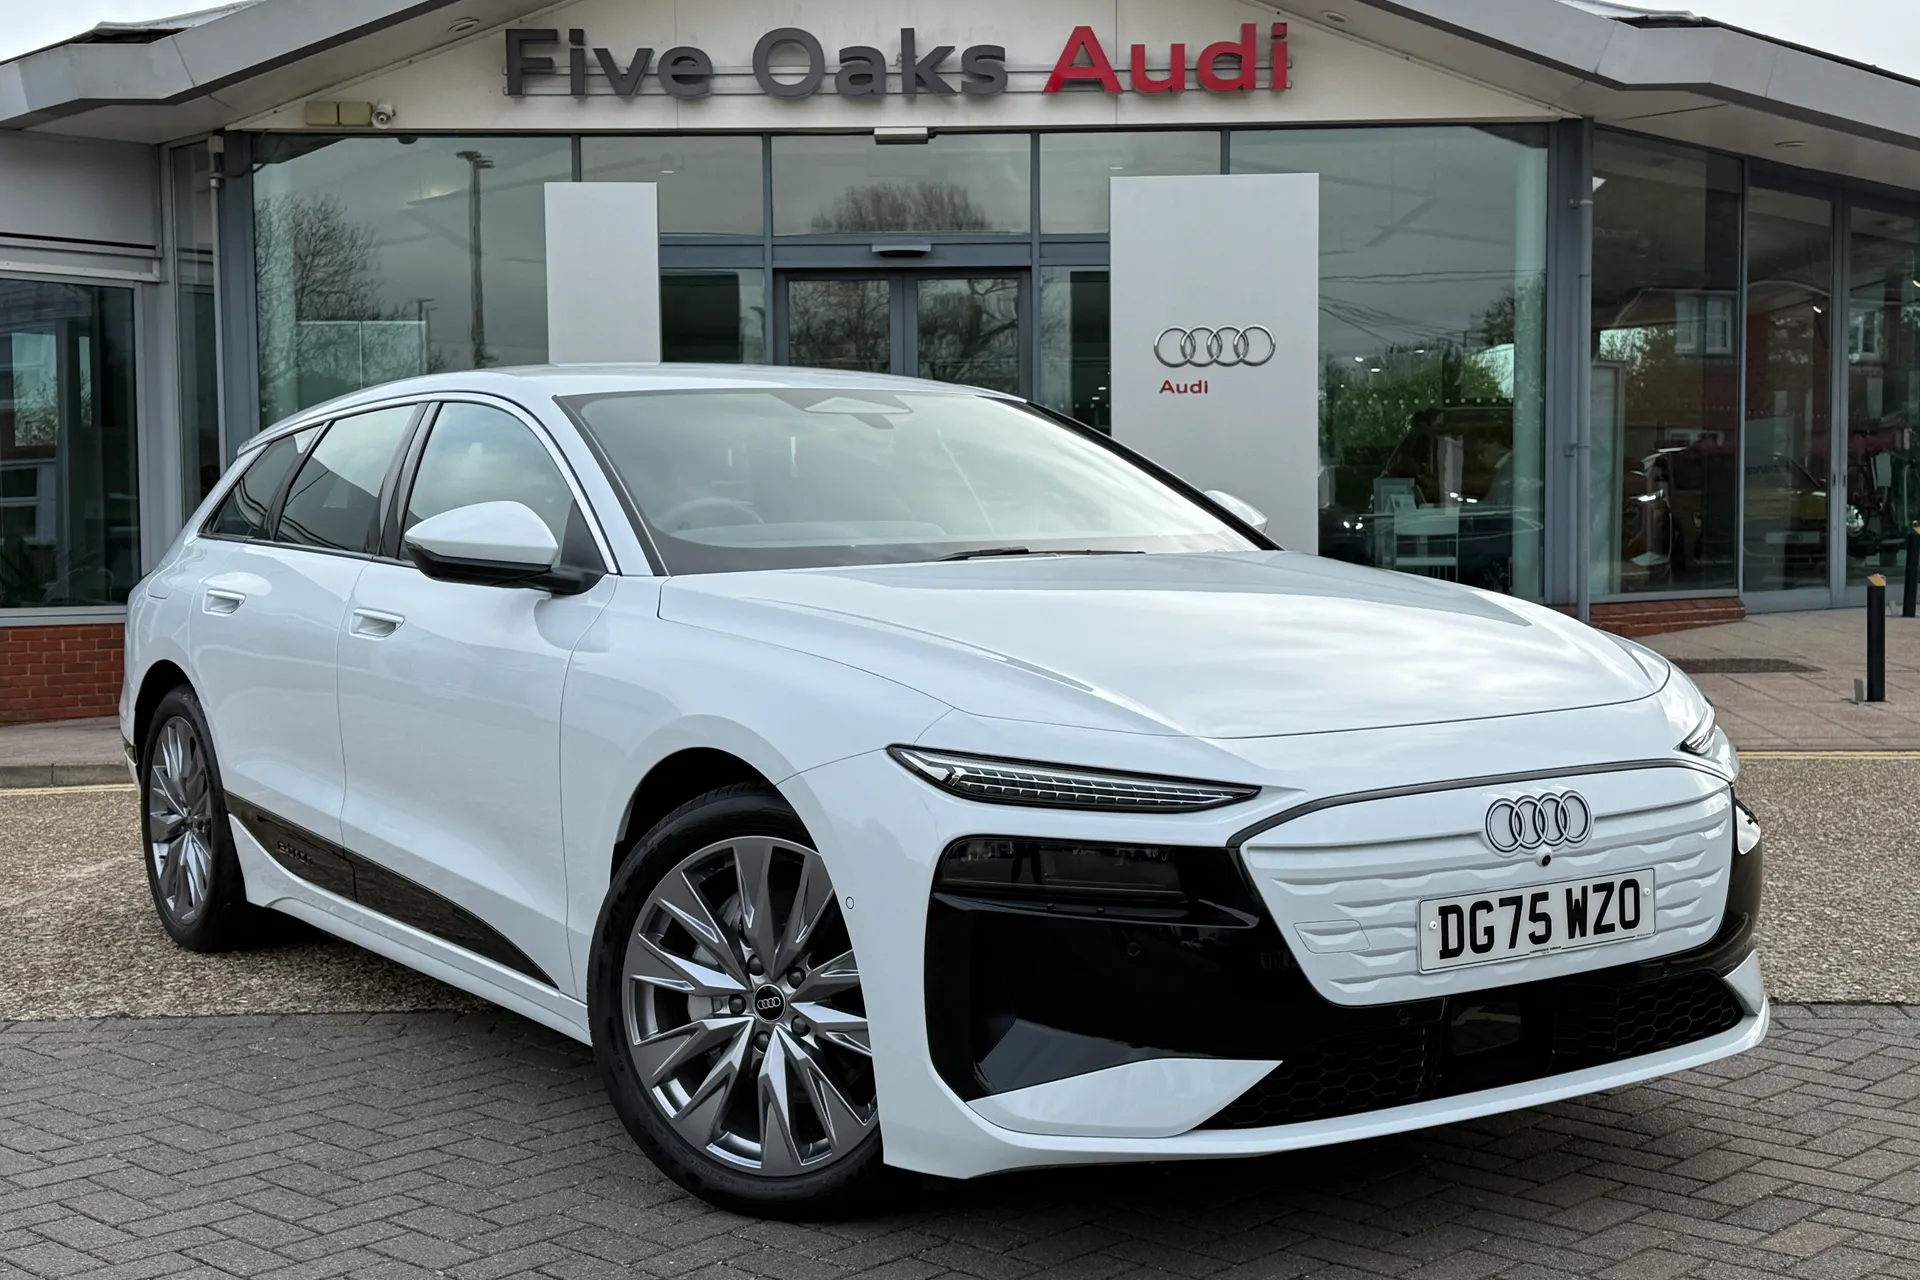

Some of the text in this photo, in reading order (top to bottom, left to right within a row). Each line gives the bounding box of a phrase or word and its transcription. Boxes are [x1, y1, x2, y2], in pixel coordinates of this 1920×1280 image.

[505, 23, 1289, 101] Five Oaks Audi
[1159, 379, 1209, 394] Audi
[1437, 878, 1641, 960] DG75 WZO
